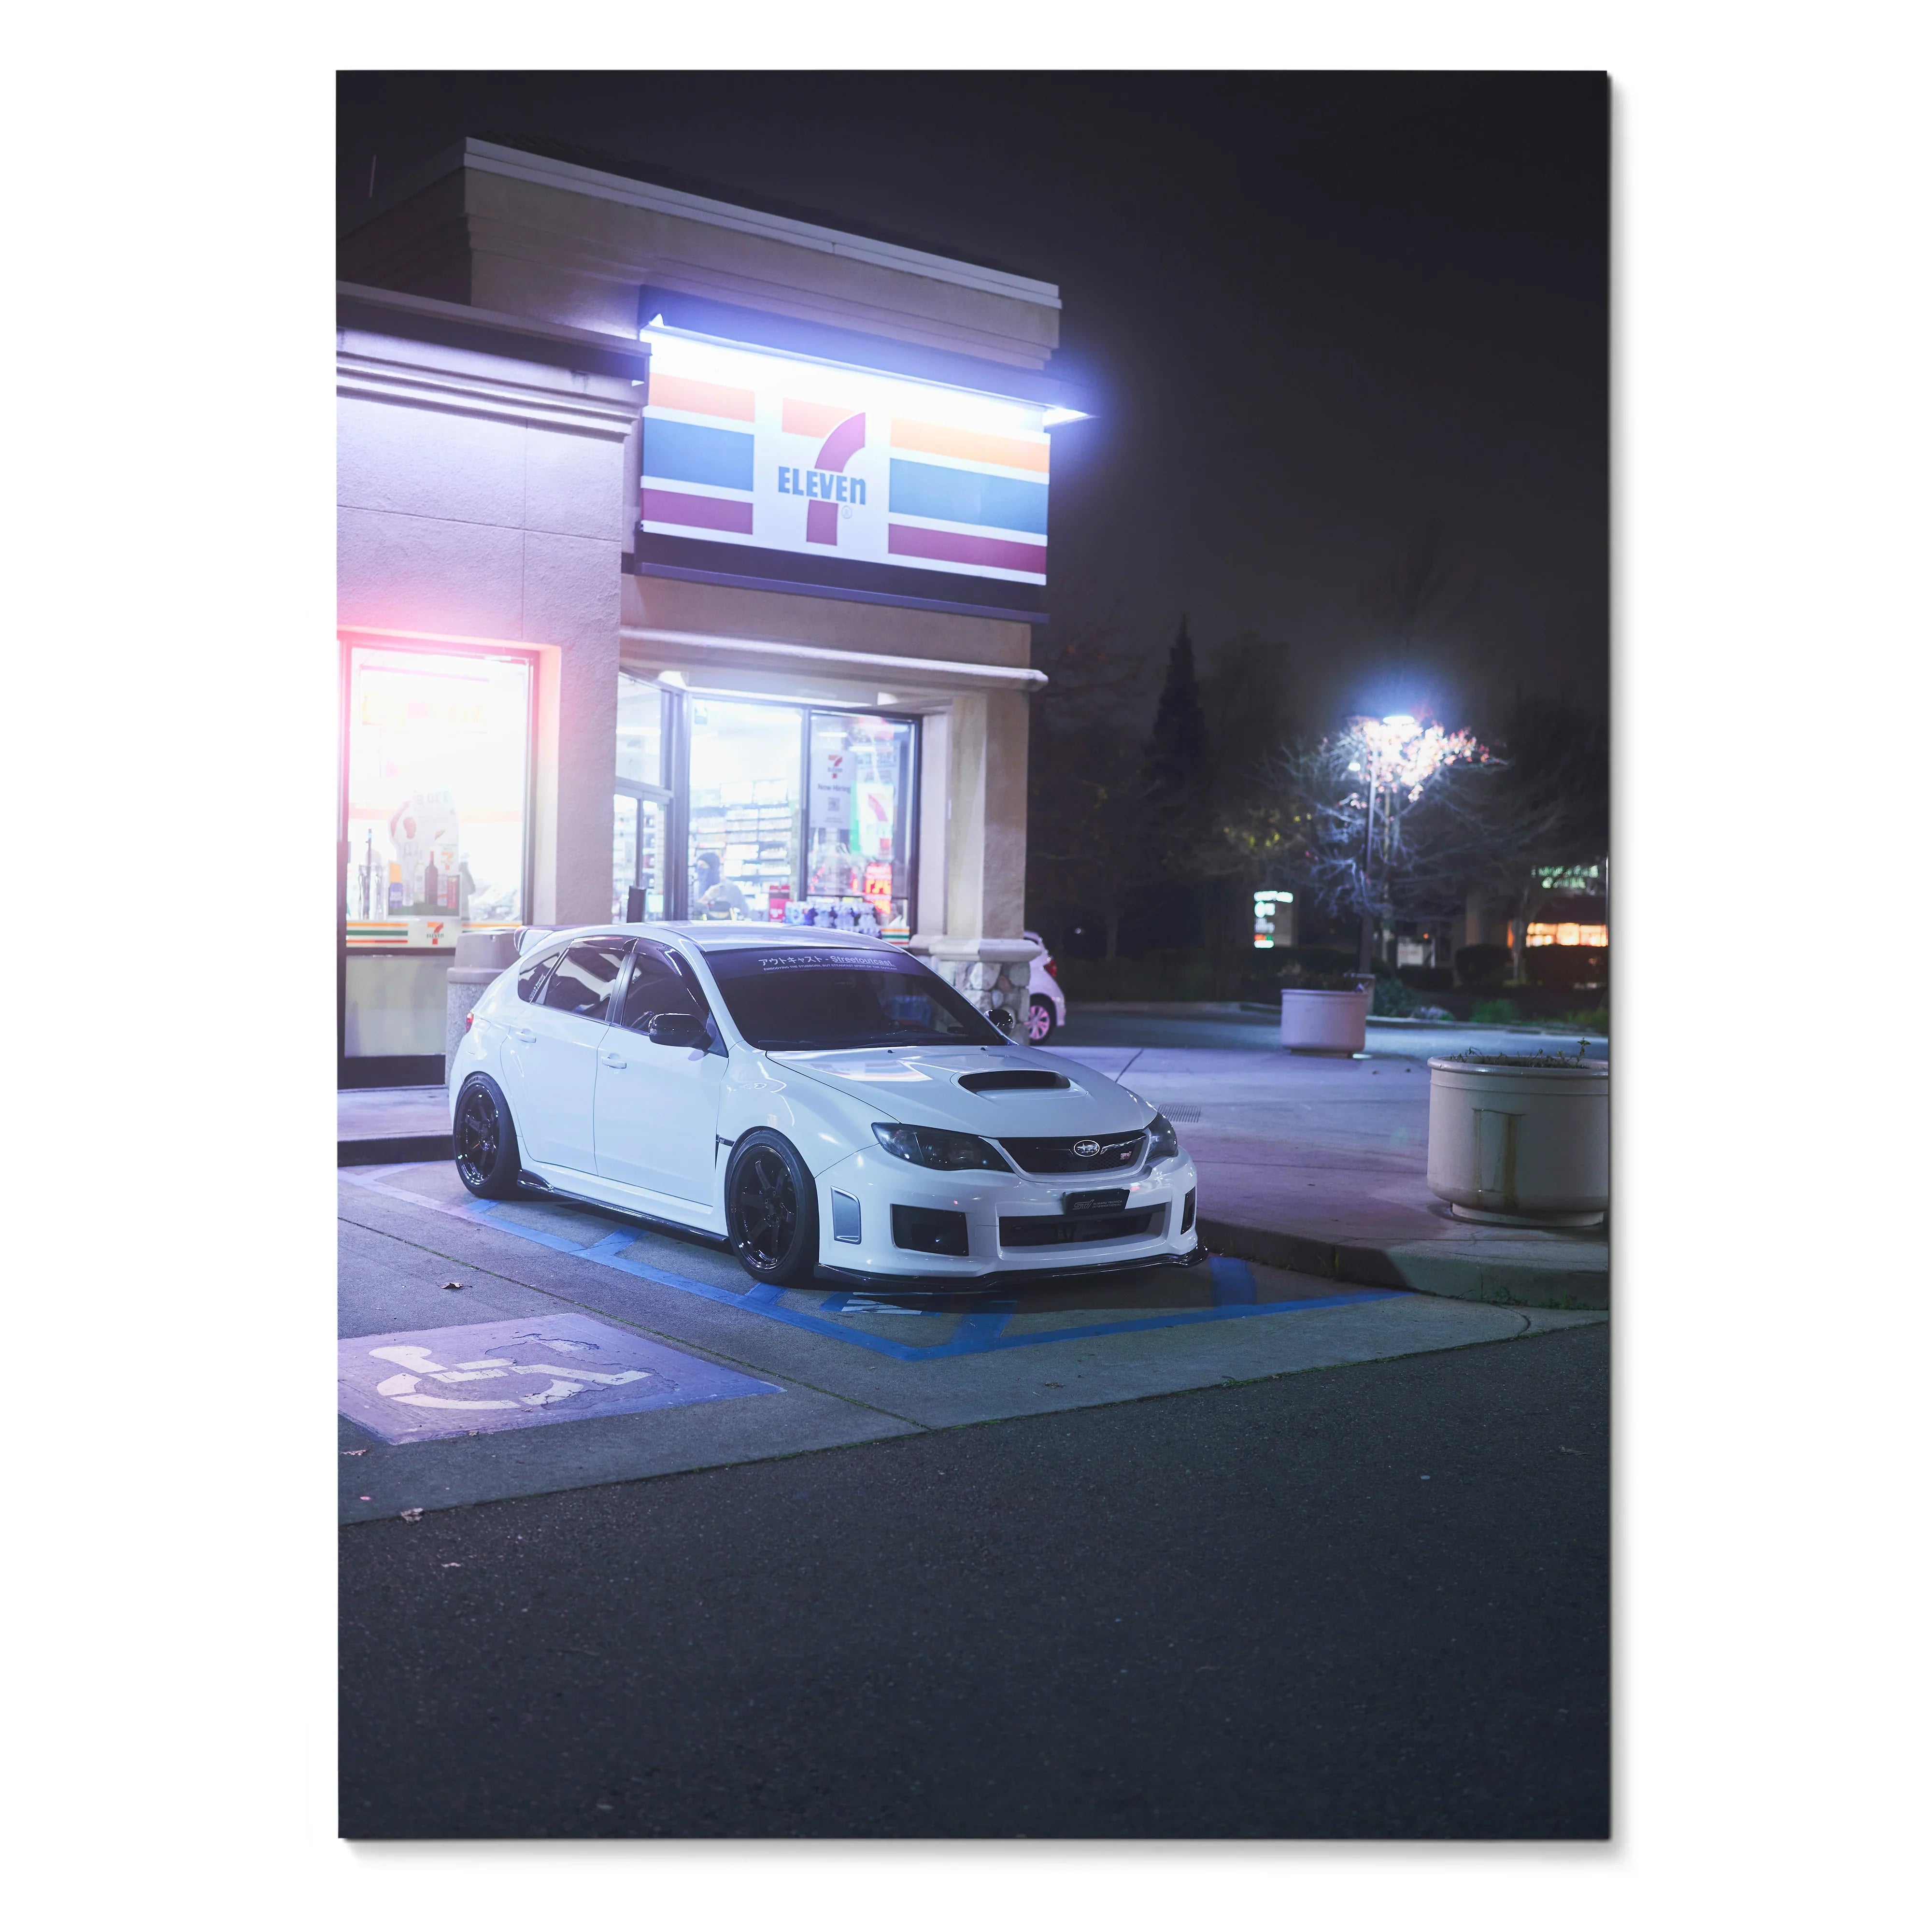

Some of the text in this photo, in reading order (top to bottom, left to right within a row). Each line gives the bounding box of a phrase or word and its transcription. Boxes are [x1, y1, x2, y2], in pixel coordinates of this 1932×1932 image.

[781, 397, 866, 547] 7
[828, 754, 842, 779] 7
[427, 922, 444, 945] 7
[758, 956, 822, 966] アウトキャスト
